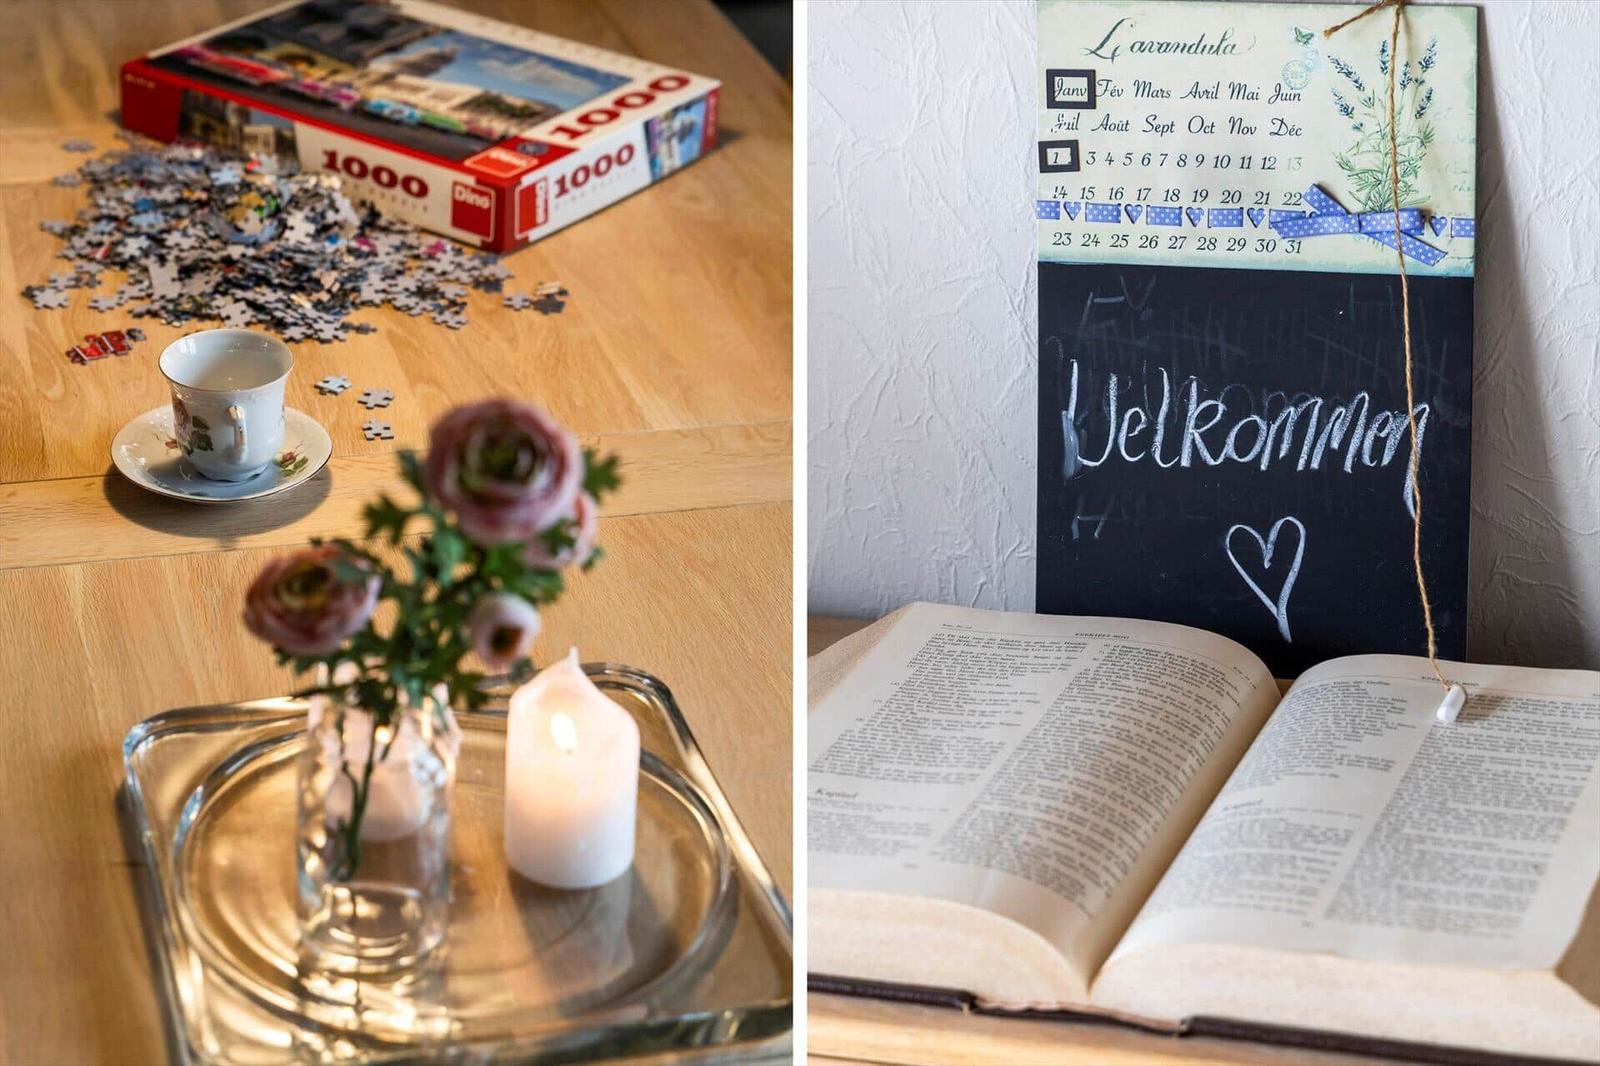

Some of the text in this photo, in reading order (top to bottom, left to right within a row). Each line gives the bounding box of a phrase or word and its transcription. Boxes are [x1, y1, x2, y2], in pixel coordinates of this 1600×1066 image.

[1081, 17, 1243, 63] Lavandula
[1054, 77, 1301, 104] Janv Fév Mars Avril Mai Juin
[550, 75, 691, 140] 1000
[1091, 113, 1130, 132] Août
[1142, 114, 1175, 137] Sept
[1188, 115, 1215, 134] Oct
[1228, 116, 1257, 135] Nov
[1269, 117, 1302, 136] Déc
[322, 149, 429, 198] 1000
[555, 143, 635, 199] 1000
[1052, 152, 1059, 164] 1
[1086, 151, 1096, 165] 3
[1105, 152, 1114, 166] 4
[1123, 152, 1133, 166] 5
[1141, 153, 1152, 166] 6
[1159, 153, 1168, 167] 7
[1176, 153, 1187, 168] 8
[1195, 154, 1205, 168] 9
[1213, 154, 1231, 169] 10
[1240, 155, 1252, 170] 11
[1260, 156, 1277, 170] 12
[1286, 157, 1302, 171] 13
[454, 185, 490, 210] Dino
[1080, 186, 1095, 200] 15
[1109, 187, 1124, 201] 16
[1136, 188, 1152, 201] 17
[1163, 188, 1180, 202] 18
[1191, 189, 1208, 203] 19
[1220, 190, 1242, 204] 20
[1253, 191, 1270, 205] 21
[1282, 192, 1303, 206] 22
[1052, 232, 1302, 254] 23 24 25 26 27 28 29 30 31
